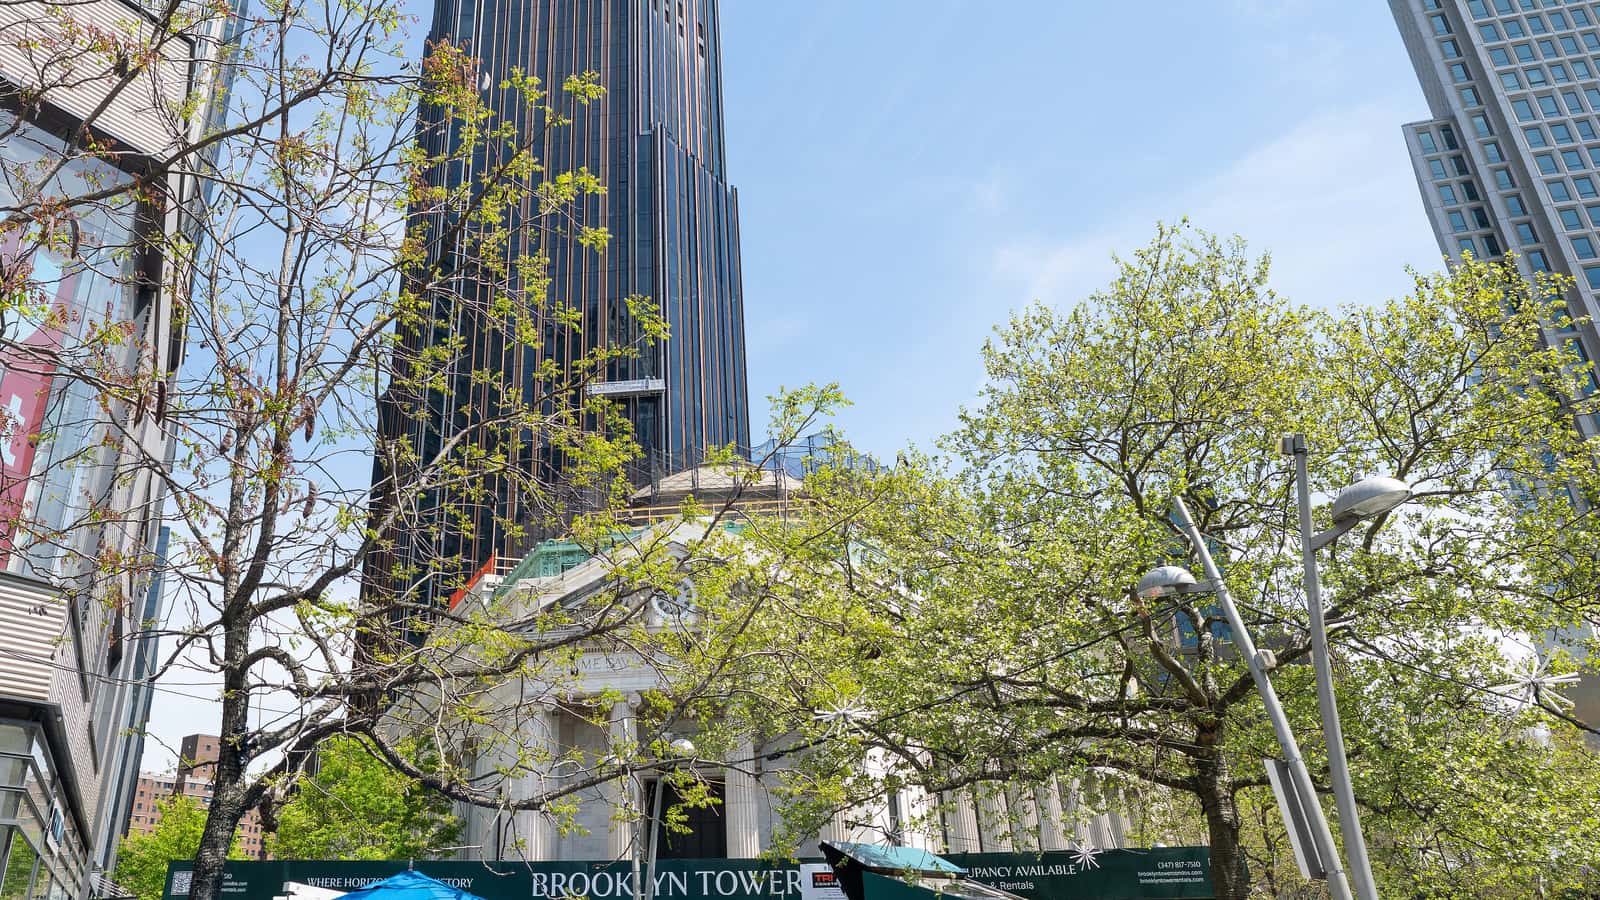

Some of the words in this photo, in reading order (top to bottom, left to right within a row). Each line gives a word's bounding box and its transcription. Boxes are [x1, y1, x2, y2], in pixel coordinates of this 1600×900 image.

[1015, 864, 1077, 877] AVAILABLE
[1157, 861, 1174, 869] (347)
[307, 877, 343, 888] WHERE
[344, 877, 387, 888] HORIZO
[532, 872, 687, 897] BROOKYN
[696, 870, 802, 896] TOWER
[999, 880, 1035, 890] Rentals
